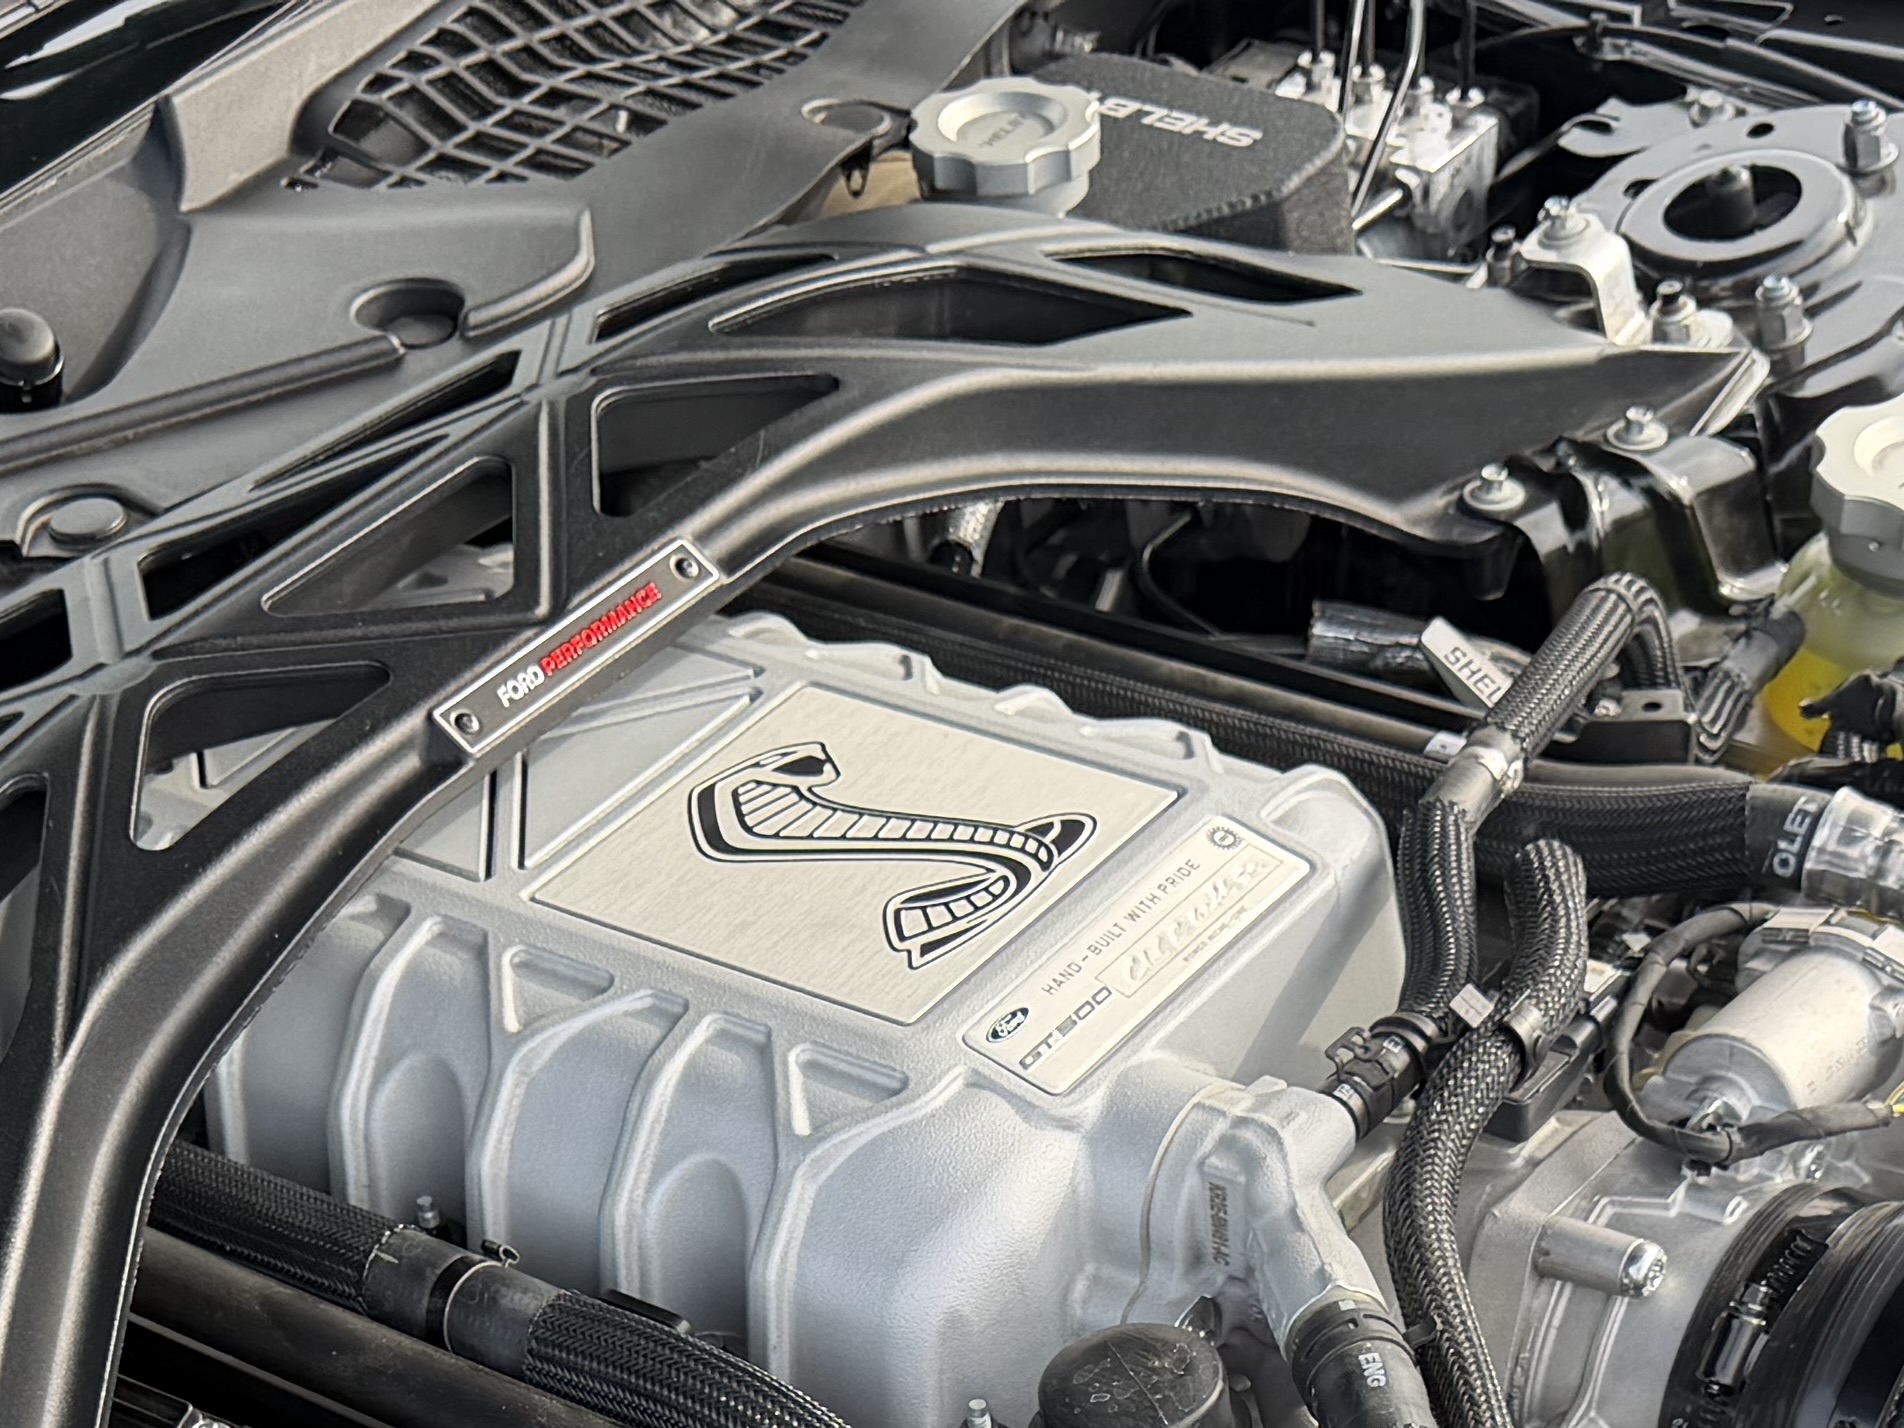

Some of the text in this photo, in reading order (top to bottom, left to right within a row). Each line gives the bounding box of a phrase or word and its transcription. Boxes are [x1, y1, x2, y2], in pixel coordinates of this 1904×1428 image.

[1096, 94, 1265, 148] SHELB
[497, 581, 663, 708] FORD PERFORMANCE
[1442, 645, 1510, 706] SHEL
[1127, 891, 1158, 924] WITH
[1157, 858, 1201, 894] PRIDE
[1358, 1351, 1388, 1388] ENG
